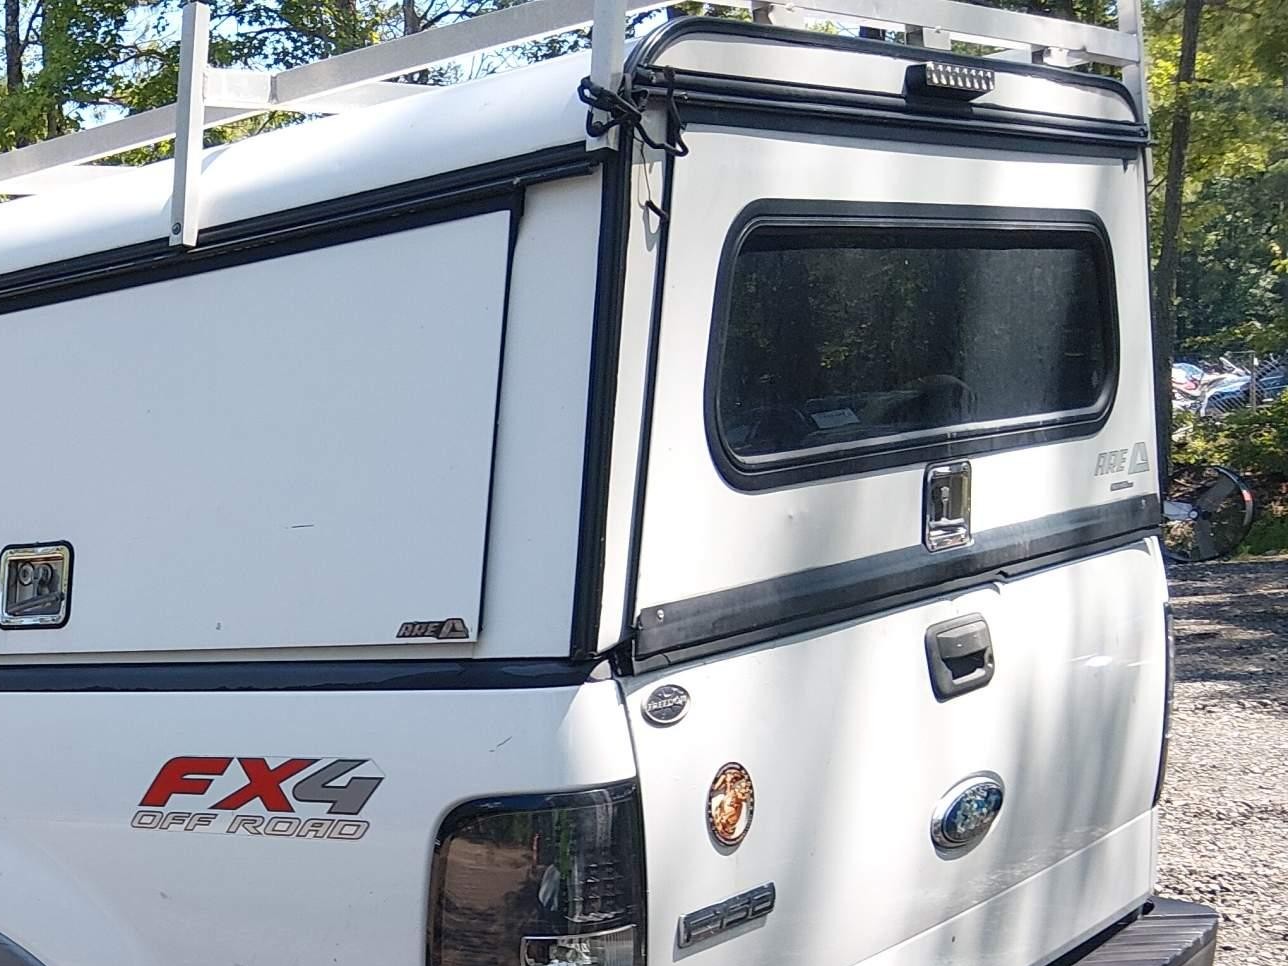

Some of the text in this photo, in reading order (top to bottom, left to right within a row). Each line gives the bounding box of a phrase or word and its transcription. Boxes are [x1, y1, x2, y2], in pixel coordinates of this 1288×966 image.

[138, 755, 385, 815] FX4
[130, 809, 371, 841] OFF ROAD
